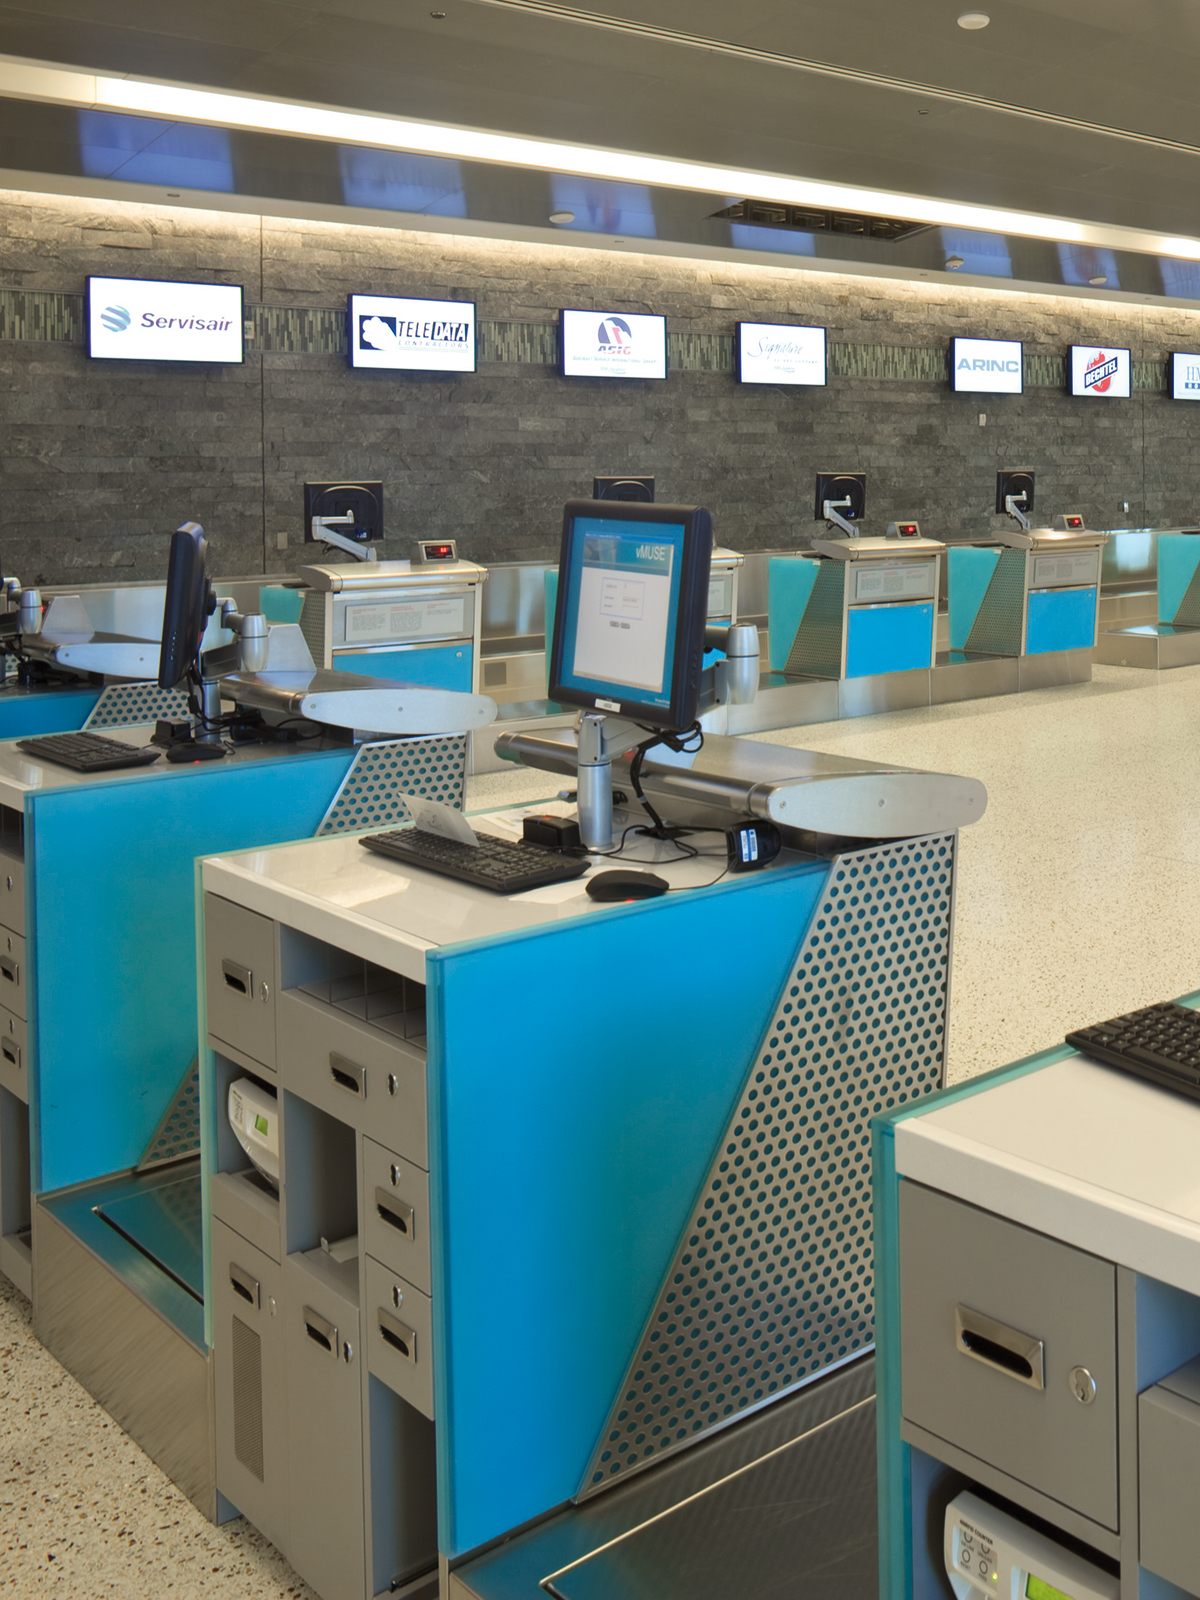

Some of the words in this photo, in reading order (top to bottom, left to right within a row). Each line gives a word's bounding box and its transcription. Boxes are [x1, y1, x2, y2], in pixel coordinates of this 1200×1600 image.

[141, 312, 233, 331] Servisair
[747, 335, 804, 360] Signature
[957, 358, 1019, 373] ARINC
[1085, 358, 1118, 387] BECHTEL
[636, 544, 666, 561] vMUSE
